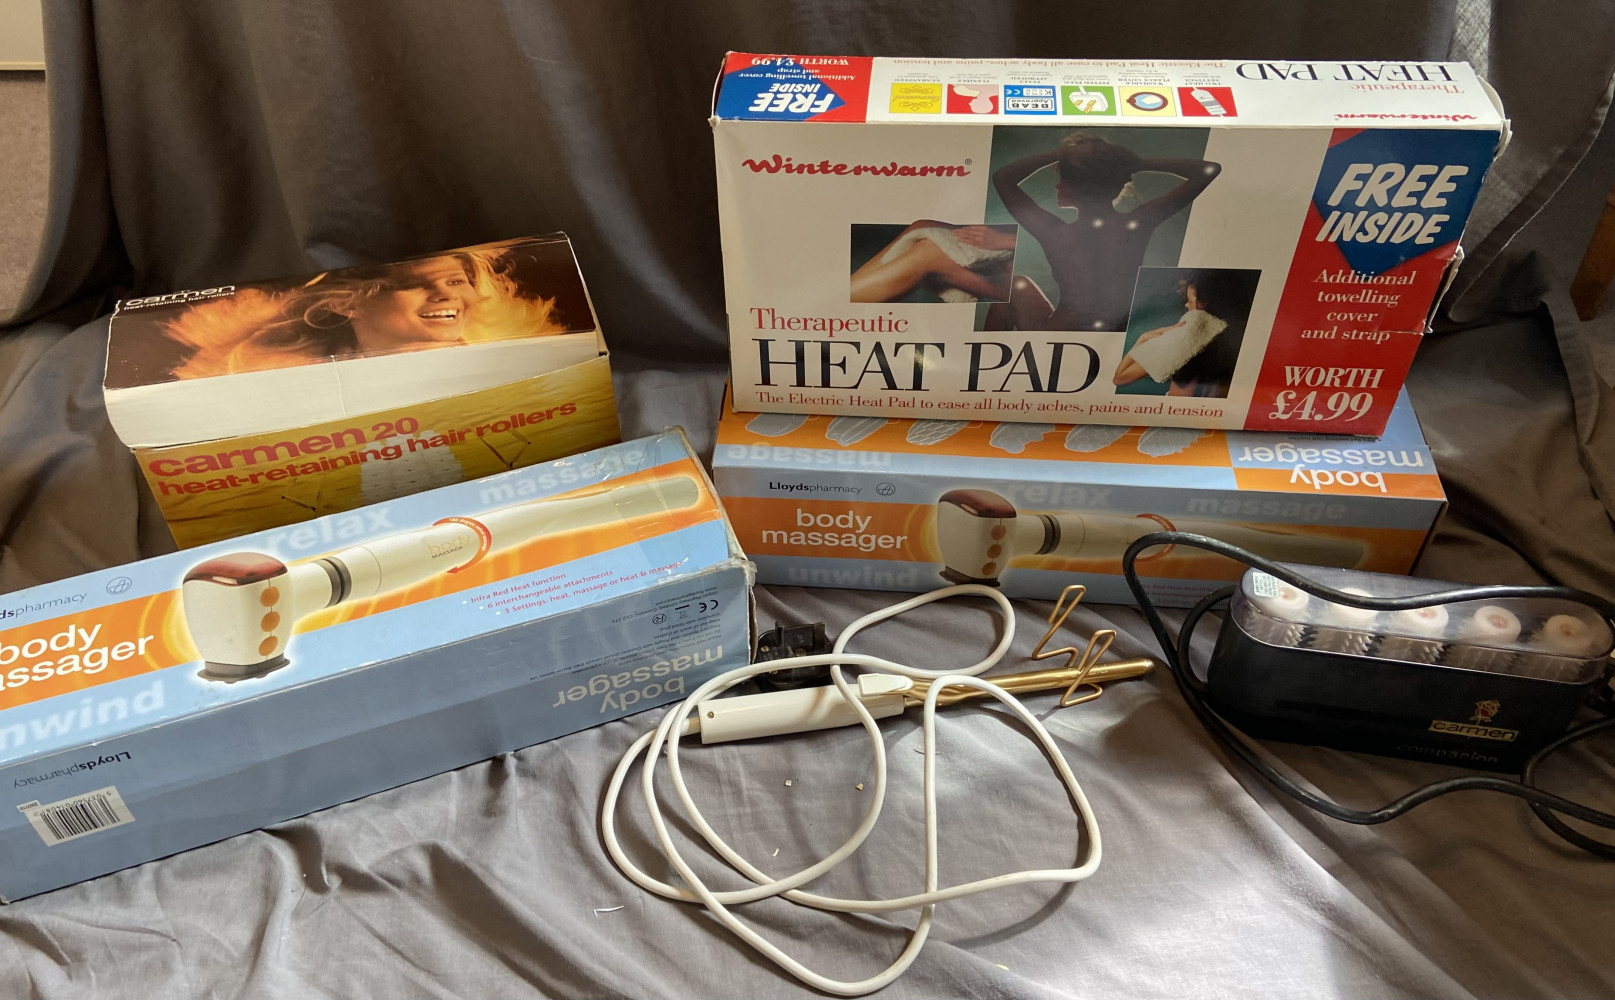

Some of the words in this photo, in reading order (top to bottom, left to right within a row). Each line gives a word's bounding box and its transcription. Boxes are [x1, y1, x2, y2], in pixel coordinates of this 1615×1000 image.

[751, 56, 796, 66] £4.99
[800, 58, 849, 66] WORTH
[1235, 62, 1324, 81] PAD
[1333, 64, 1458, 82] HEAT
[768, 82, 821, 93] INSIDE
[1350, 83, 1465, 94] Therapeutic
[748, 92, 836, 113] FREE
[1327, 163, 1469, 208] FREE
[1315, 211, 1450, 244] INSIDE
[1313, 269, 1417, 286] Additional
[1317, 291, 1401, 308] towelling
[750, 307, 909, 338] Therapeutic
[1326, 312, 1378, 322] cover
[1301, 327, 1337, 340] and
[1341, 328, 1391, 344] strap
[752, 338, 946, 392] HEAT
[959, 340, 1100, 394] PAD
[1284, 366, 1385, 388] WORTH
[756, 391, 784, 404] The
[789, 393, 844, 406] Electric
[850, 395, 882, 408] Heat
[888, 396, 916, 408] Pad
[920, 398, 934, 409] to
[937, 401, 970, 410] ease
[974, 398, 992, 410] all
[997, 398, 1032, 414] body
[1088, 400, 1130, 416] pains
[1134, 402, 1164, 416] and
[1167, 402, 1224, 418] tension
[1268, 390, 1374, 422] £4.99
[149, 427, 367, 477] carmen
[371, 416, 418, 442] 20
[158, 443, 403, 496] heat-retaining
[407, 426, 472, 452] hair
[476, 402, 578, 438] rollers
[1238, 442, 1424, 468] massager
[769, 482, 862, 494] Lloydspharmacy
[1290, 464, 1388, 492] body
[265, 506, 396, 550] relax
[796, 508, 872, 534] body
[762, 530, 908, 552] massager
[470, 591, 491, 604] Infra
[492, 587, 509, 598] Red
[510, 582, 530, 594] Heat
[532, 573, 566, 588] function
[495, 584, 562, 608] interchangeable
[563, 569, 614, 589] attachments
[573, 582, 608, 597] massage
[609, 578, 618, 586] or
[620, 573, 638, 584] heat
[553, 645, 723, 708] massager
[600, 676, 685, 714] body
[1433, 721, 1516, 740] carmen
[14, 751, 132, 788] Lloydspharmacy
